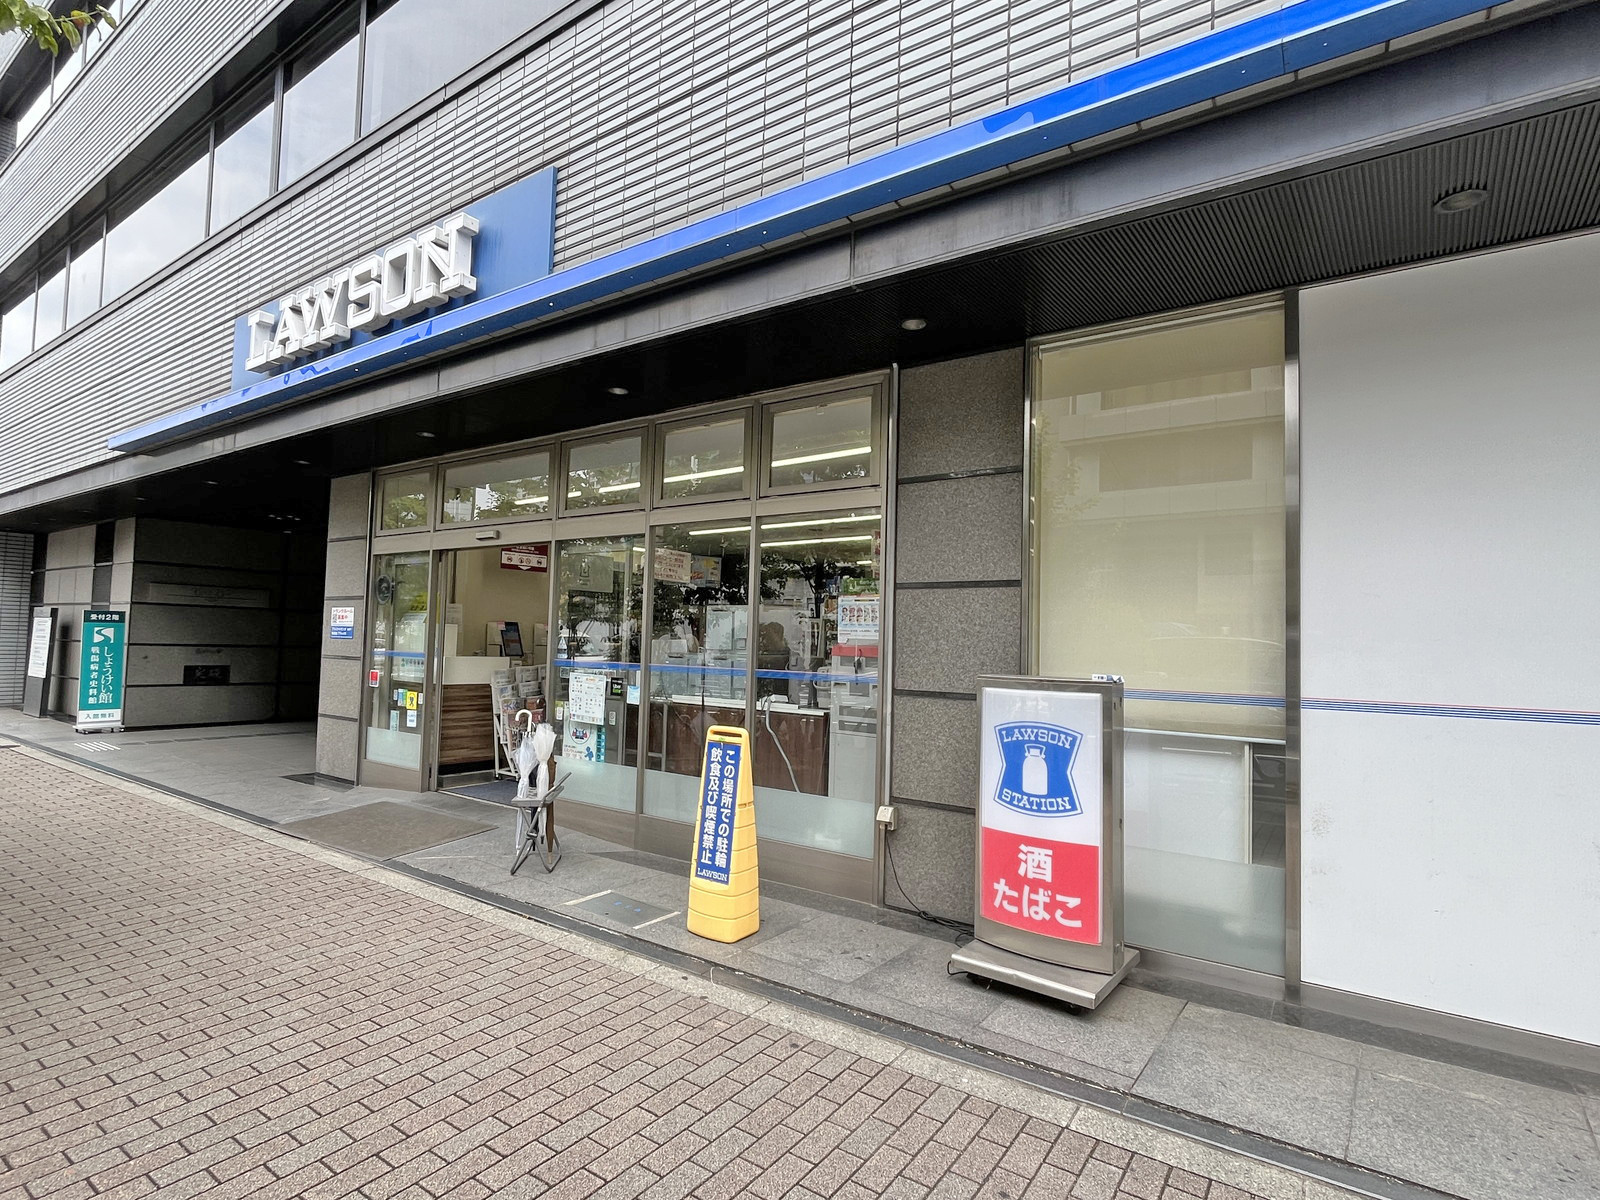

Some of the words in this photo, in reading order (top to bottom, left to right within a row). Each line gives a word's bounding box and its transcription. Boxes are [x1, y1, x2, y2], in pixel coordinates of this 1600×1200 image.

[245, 212, 479, 373] LAWSON
[98, 646, 114, 704] しょうけい館
[1002, 728, 1073, 749] LAWSON
[701, 747, 722, 865] 飲食及び喫煙禁止
[714, 750, 736, 868] この場所での駐輪
[1002, 787, 1072, 811] STATION
[697, 868, 728, 882] LAWSON
[1017, 844, 1053, 883] 酒
[993, 878, 1083, 928] たばこ
